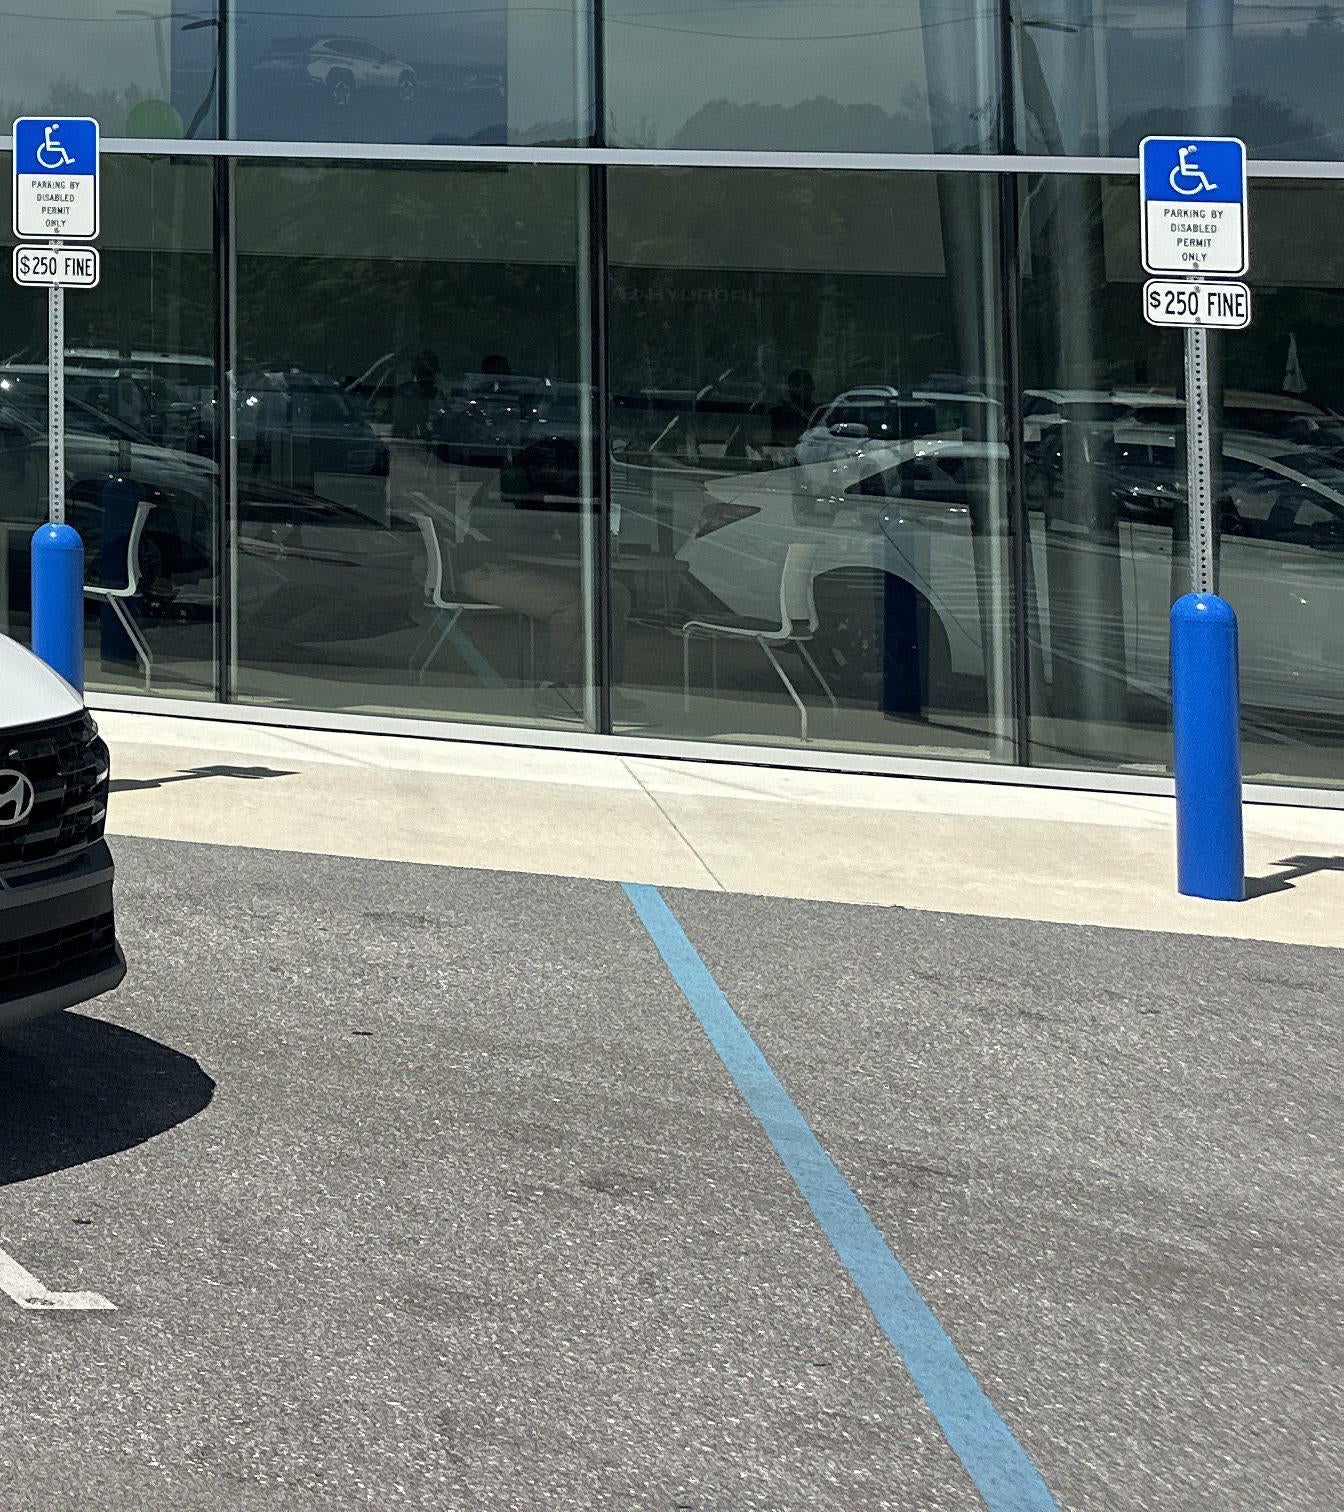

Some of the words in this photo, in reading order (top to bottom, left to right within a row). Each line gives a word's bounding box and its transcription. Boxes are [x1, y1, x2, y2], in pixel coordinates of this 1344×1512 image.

[31, 180, 66, 190] PARKING
[69, 180, 80, 190] BY
[36, 193, 75, 203] DISABLED
[41, 206, 70, 215] PERMIT
[1163, 208, 1207, 219] PARKING
[1211, 209, 1224, 219] BY
[45, 219, 66, 228] ONLY
[1170, 223, 1217, 234] DISABLED
[1176, 237, 1212, 248] PERMIT
[1181, 252, 1208, 262] ONLY
[20, 254, 58, 276] $250
[64, 256, 93, 277] FINE
[1149, 290, 1199, 316] $250
[1207, 291, 1245, 318] FINE
